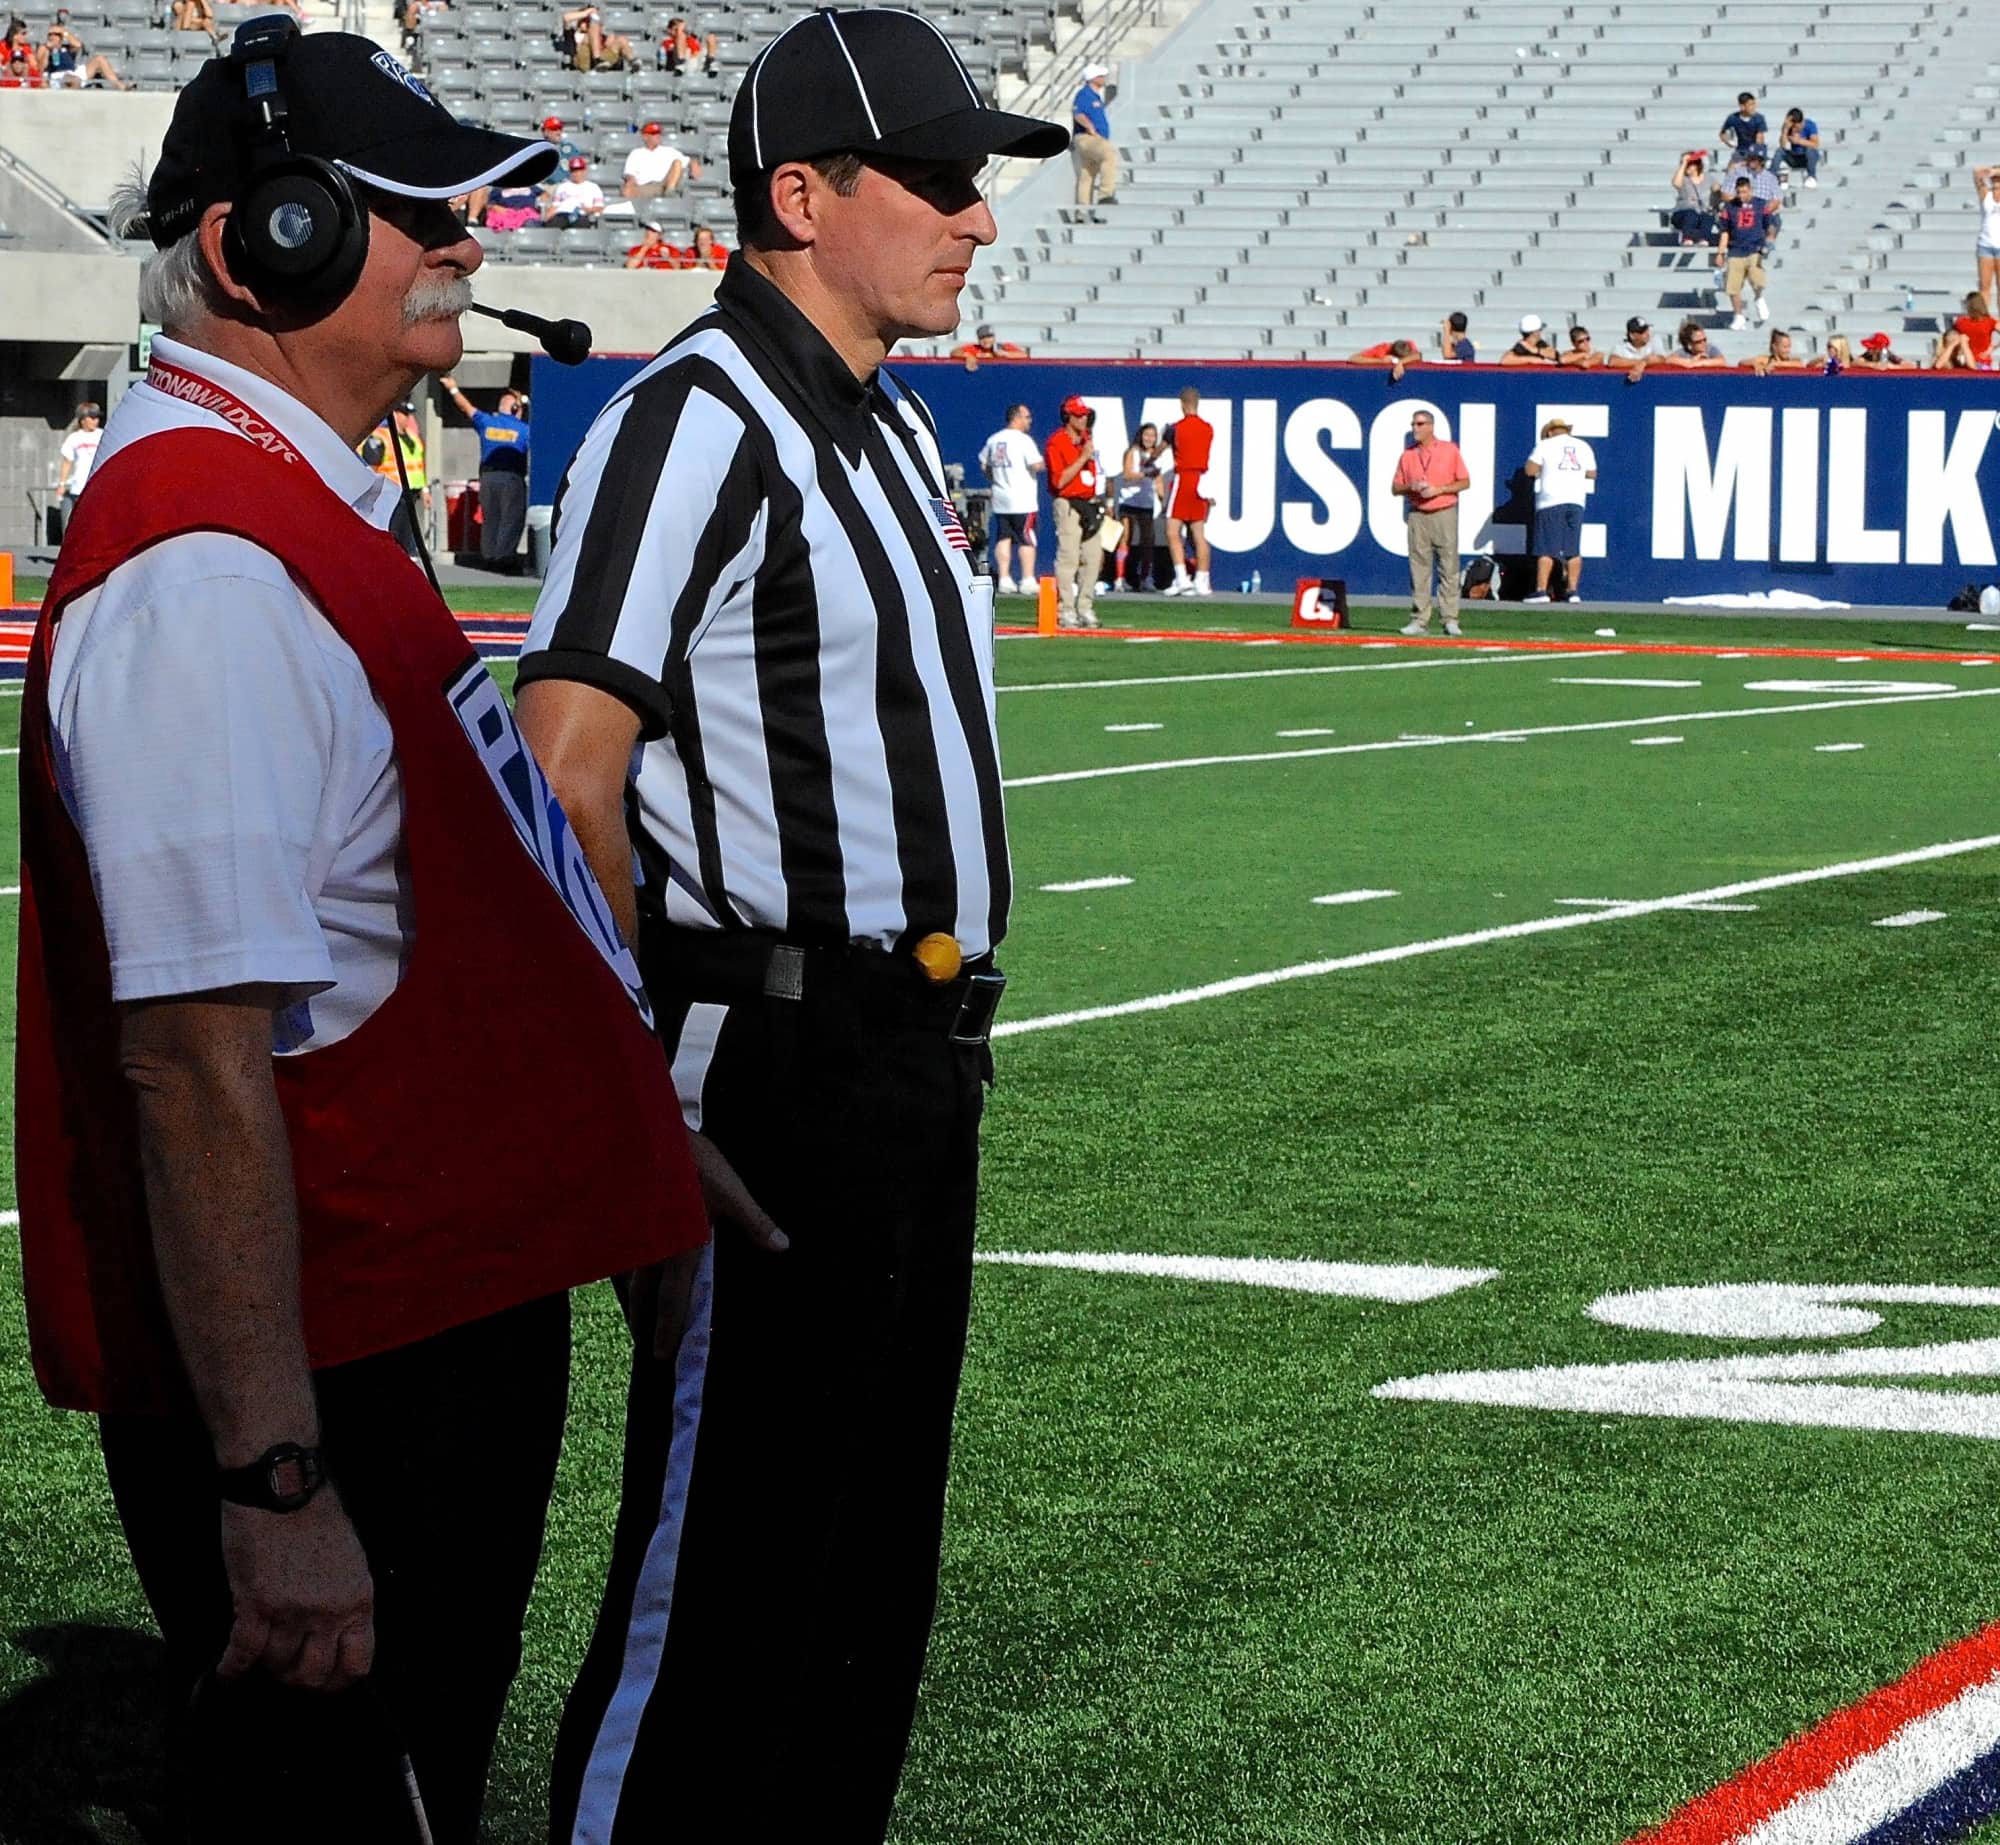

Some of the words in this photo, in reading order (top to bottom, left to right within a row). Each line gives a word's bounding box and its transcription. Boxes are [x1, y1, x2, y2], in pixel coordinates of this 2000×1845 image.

[1736, 210, 1755, 230] 15
[1558, 446, 1582, 471] A
[1078, 396, 1609, 558] MUSCLE
[1651, 405, 1998, 566] MILK
[1299, 586, 1337, 621] G
